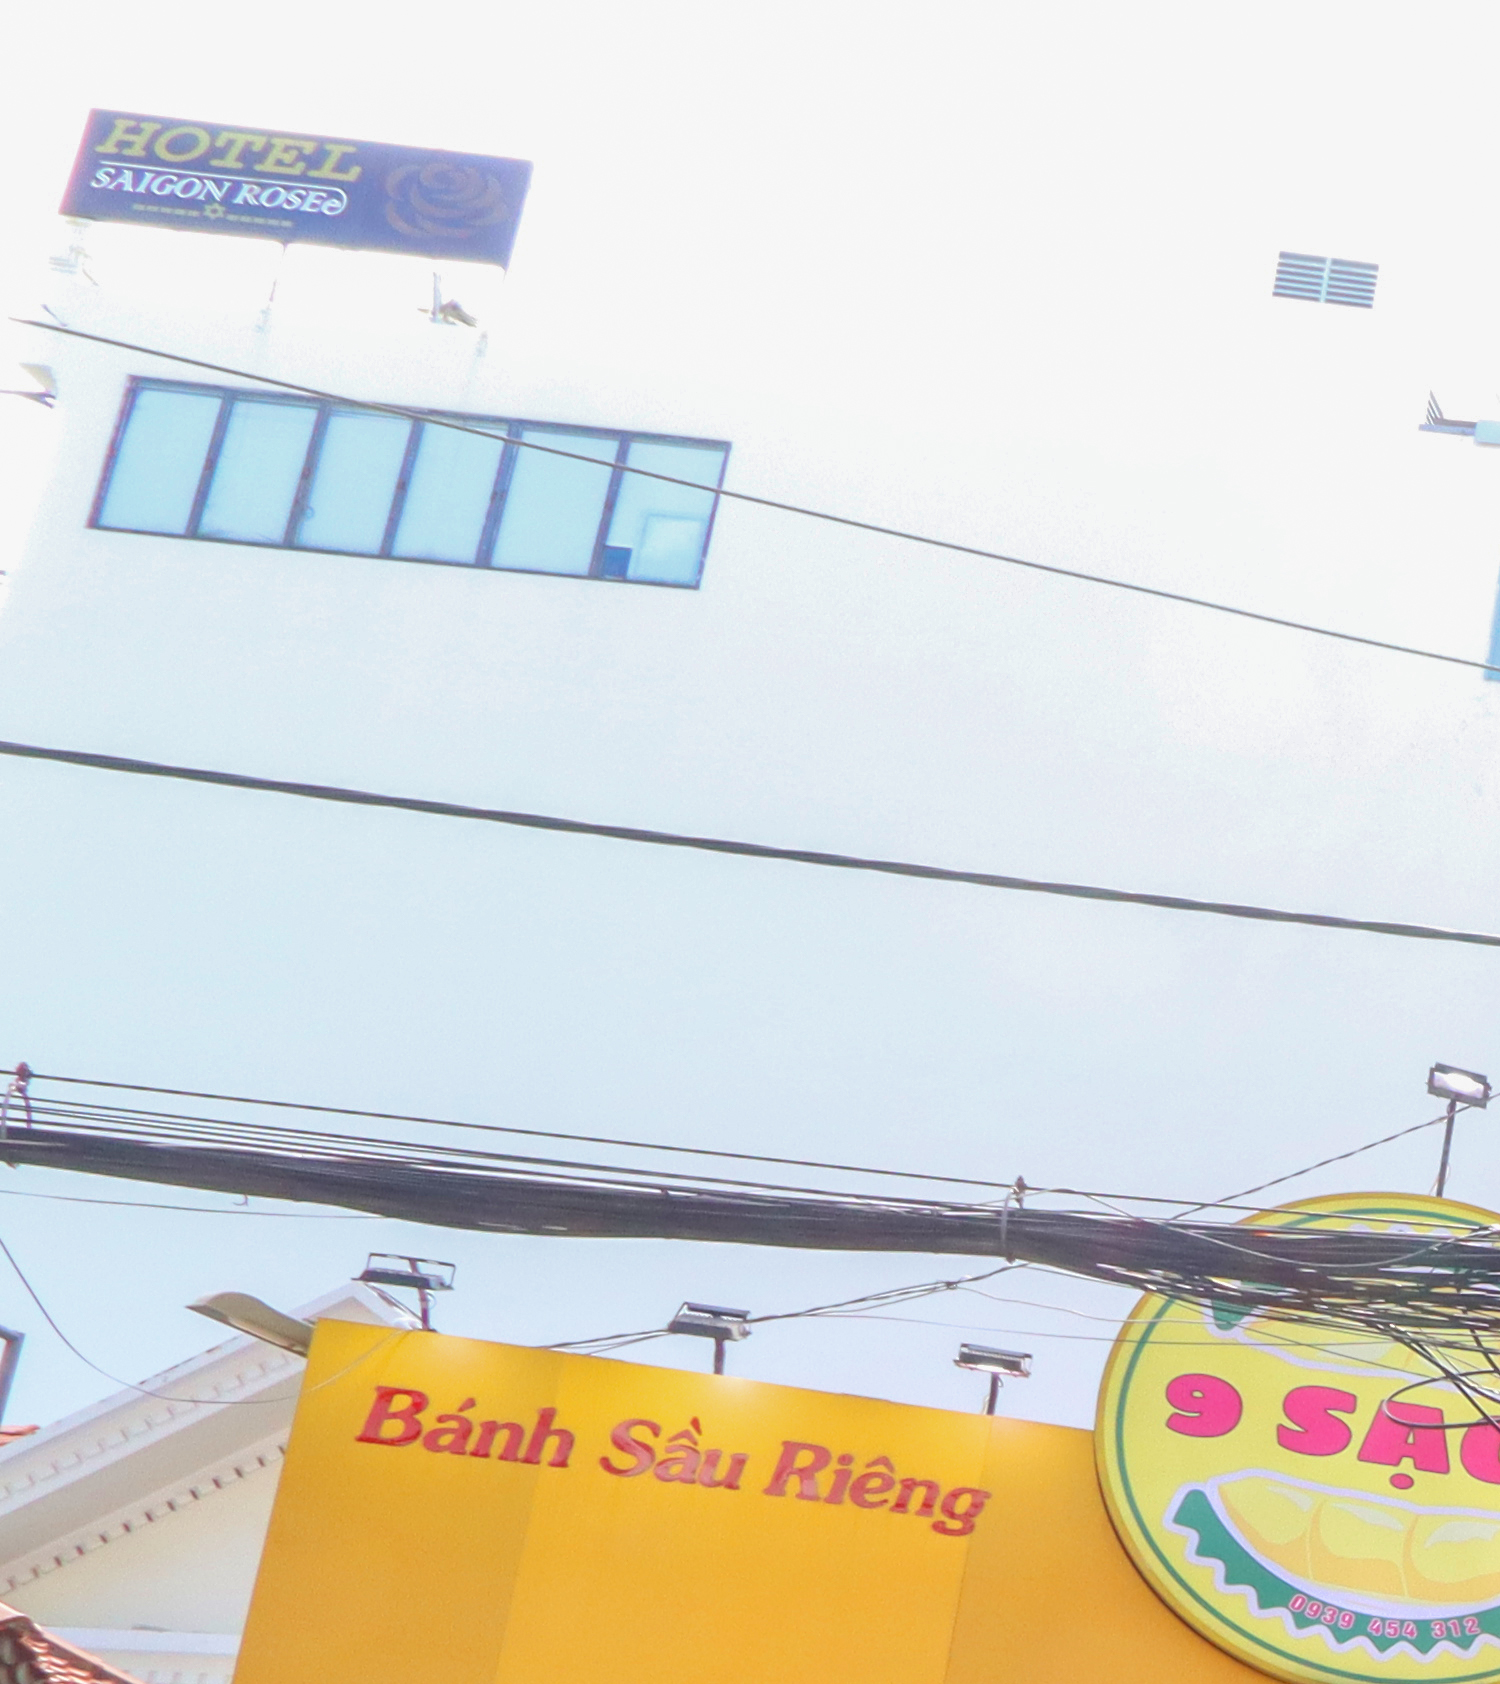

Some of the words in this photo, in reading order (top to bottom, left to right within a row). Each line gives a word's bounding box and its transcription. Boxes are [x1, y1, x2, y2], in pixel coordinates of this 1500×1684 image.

[95, 118, 361, 182] HOTEL
[90, 166, 230, 202] SAIGON
[1164, 1373, 1243, 1438] 9
[354, 1385, 576, 1469] Bánh
[599, 1416, 750, 1491] Sầu
[764, 1438, 991, 1536] Riêng
[1288, 1594, 1355, 1629] 0939
[1367, 1617, 1417, 1639] 454
[1431, 1616, 1480, 1638] 312
